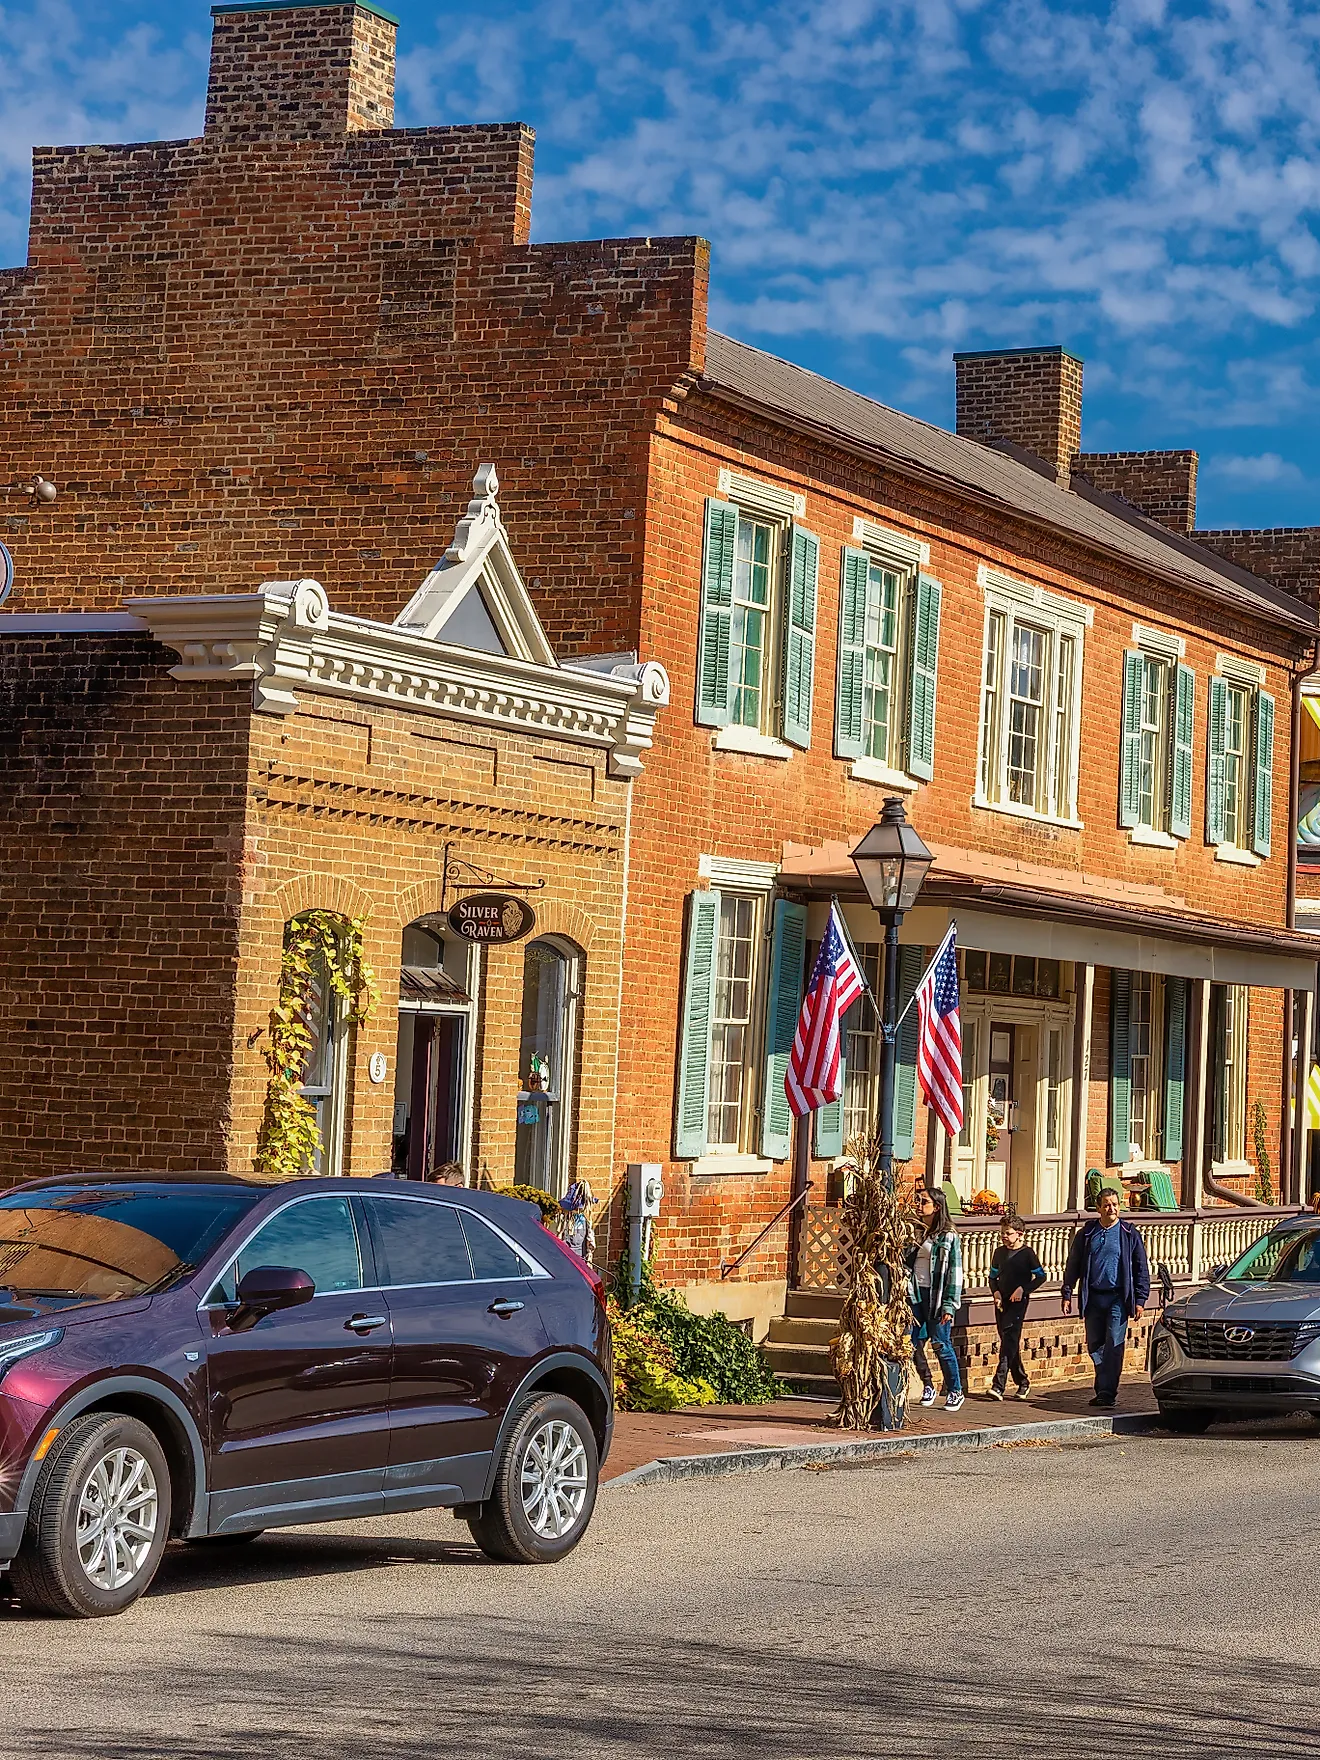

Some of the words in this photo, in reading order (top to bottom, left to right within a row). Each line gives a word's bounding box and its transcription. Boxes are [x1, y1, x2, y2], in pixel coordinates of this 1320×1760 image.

[460, 902, 499, 919] SILVER
[461, 919, 503, 939] RAVEN
[375, 1065, 381, 1077] 5
